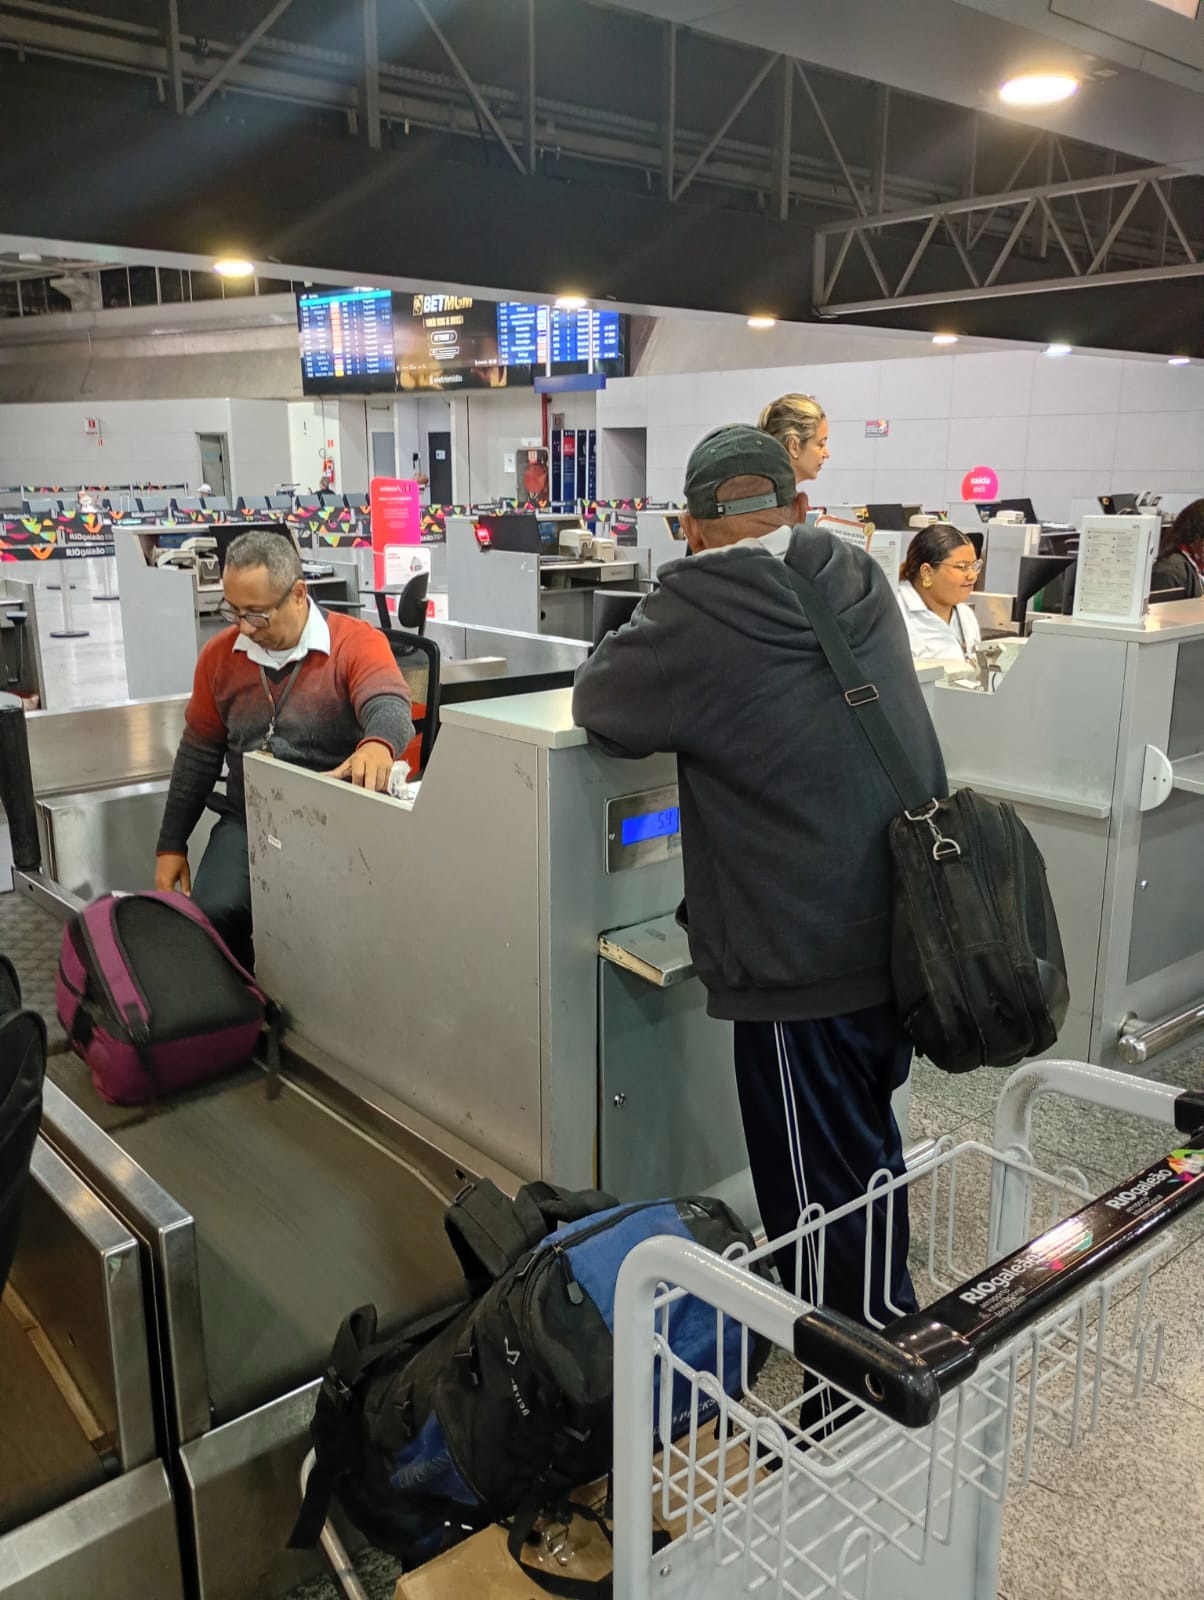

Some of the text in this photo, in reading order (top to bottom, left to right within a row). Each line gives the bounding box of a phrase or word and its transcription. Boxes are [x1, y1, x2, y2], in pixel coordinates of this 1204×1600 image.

[423, 295, 473, 313] BETMGM
[1104, 1169, 1173, 1210] RIOgaleão
[959, 1252, 1041, 1305] RIOgaleão
